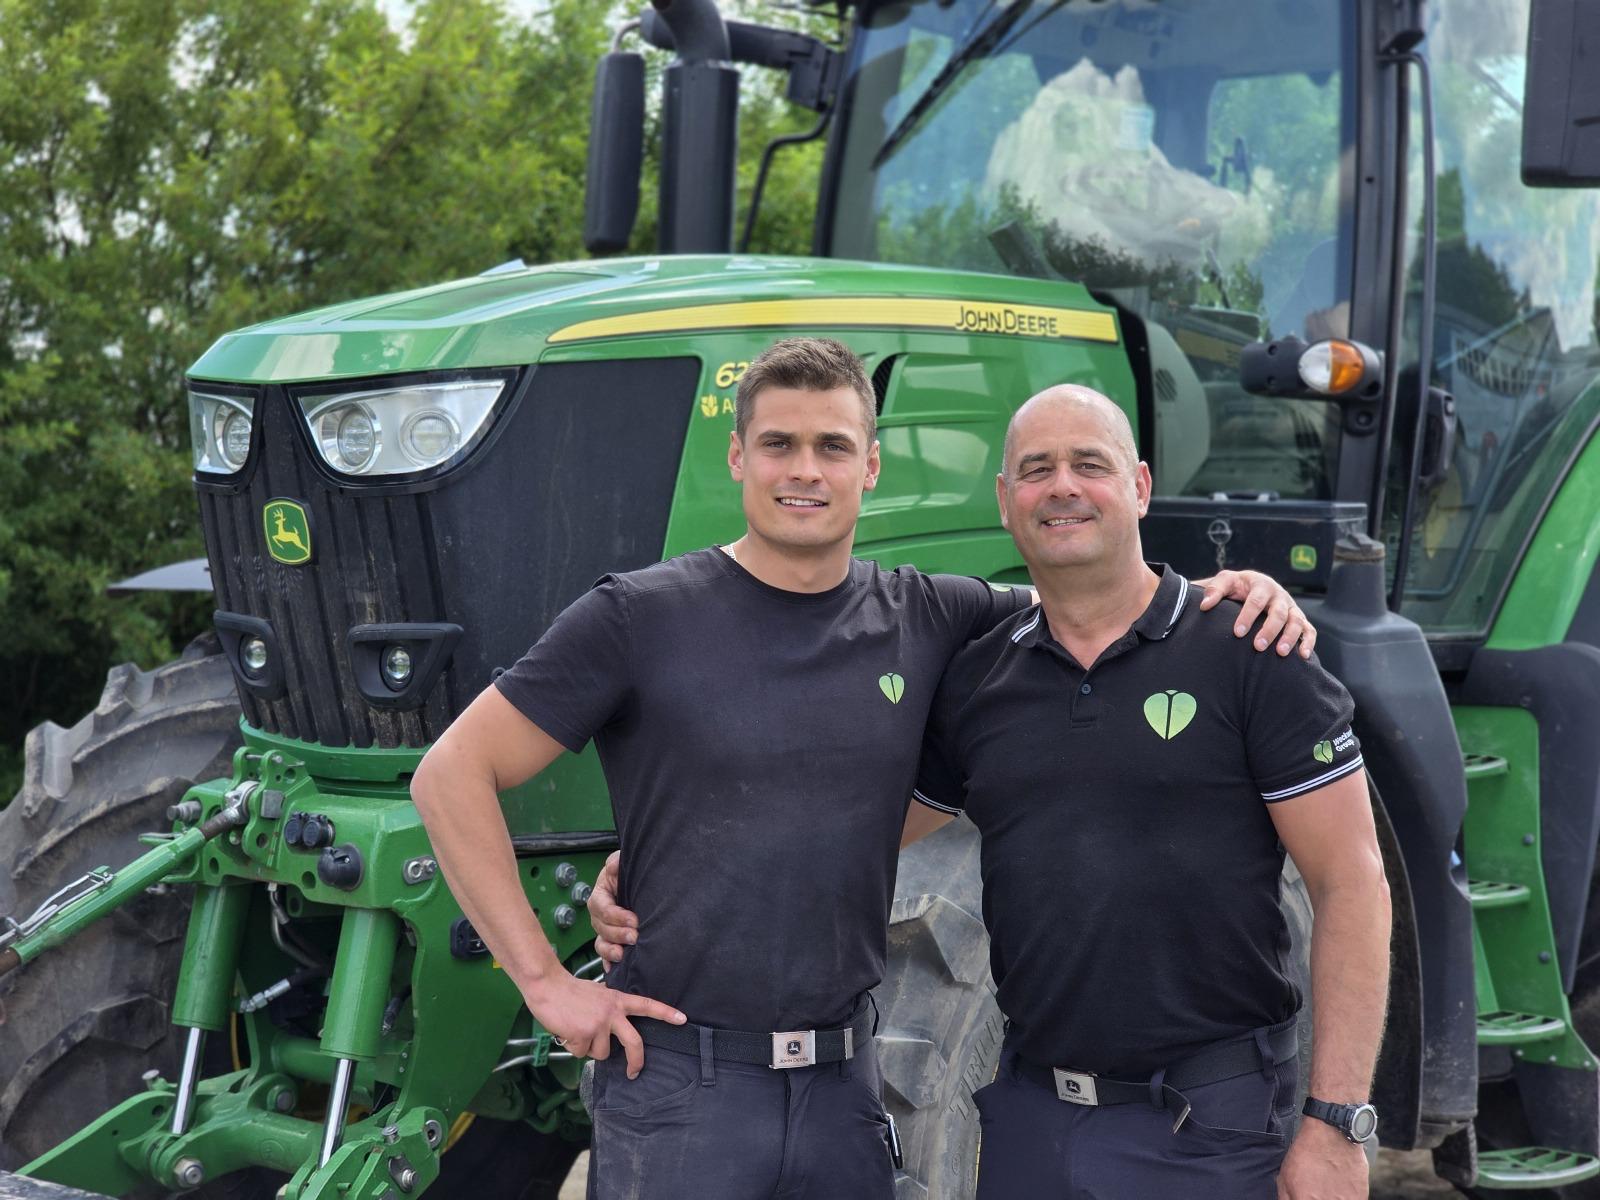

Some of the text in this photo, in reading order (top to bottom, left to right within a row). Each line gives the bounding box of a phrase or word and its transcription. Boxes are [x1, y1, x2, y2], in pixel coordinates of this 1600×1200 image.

[955, 304, 1058, 335] JOHN DEERE
[715, 361, 750, 388] 62
